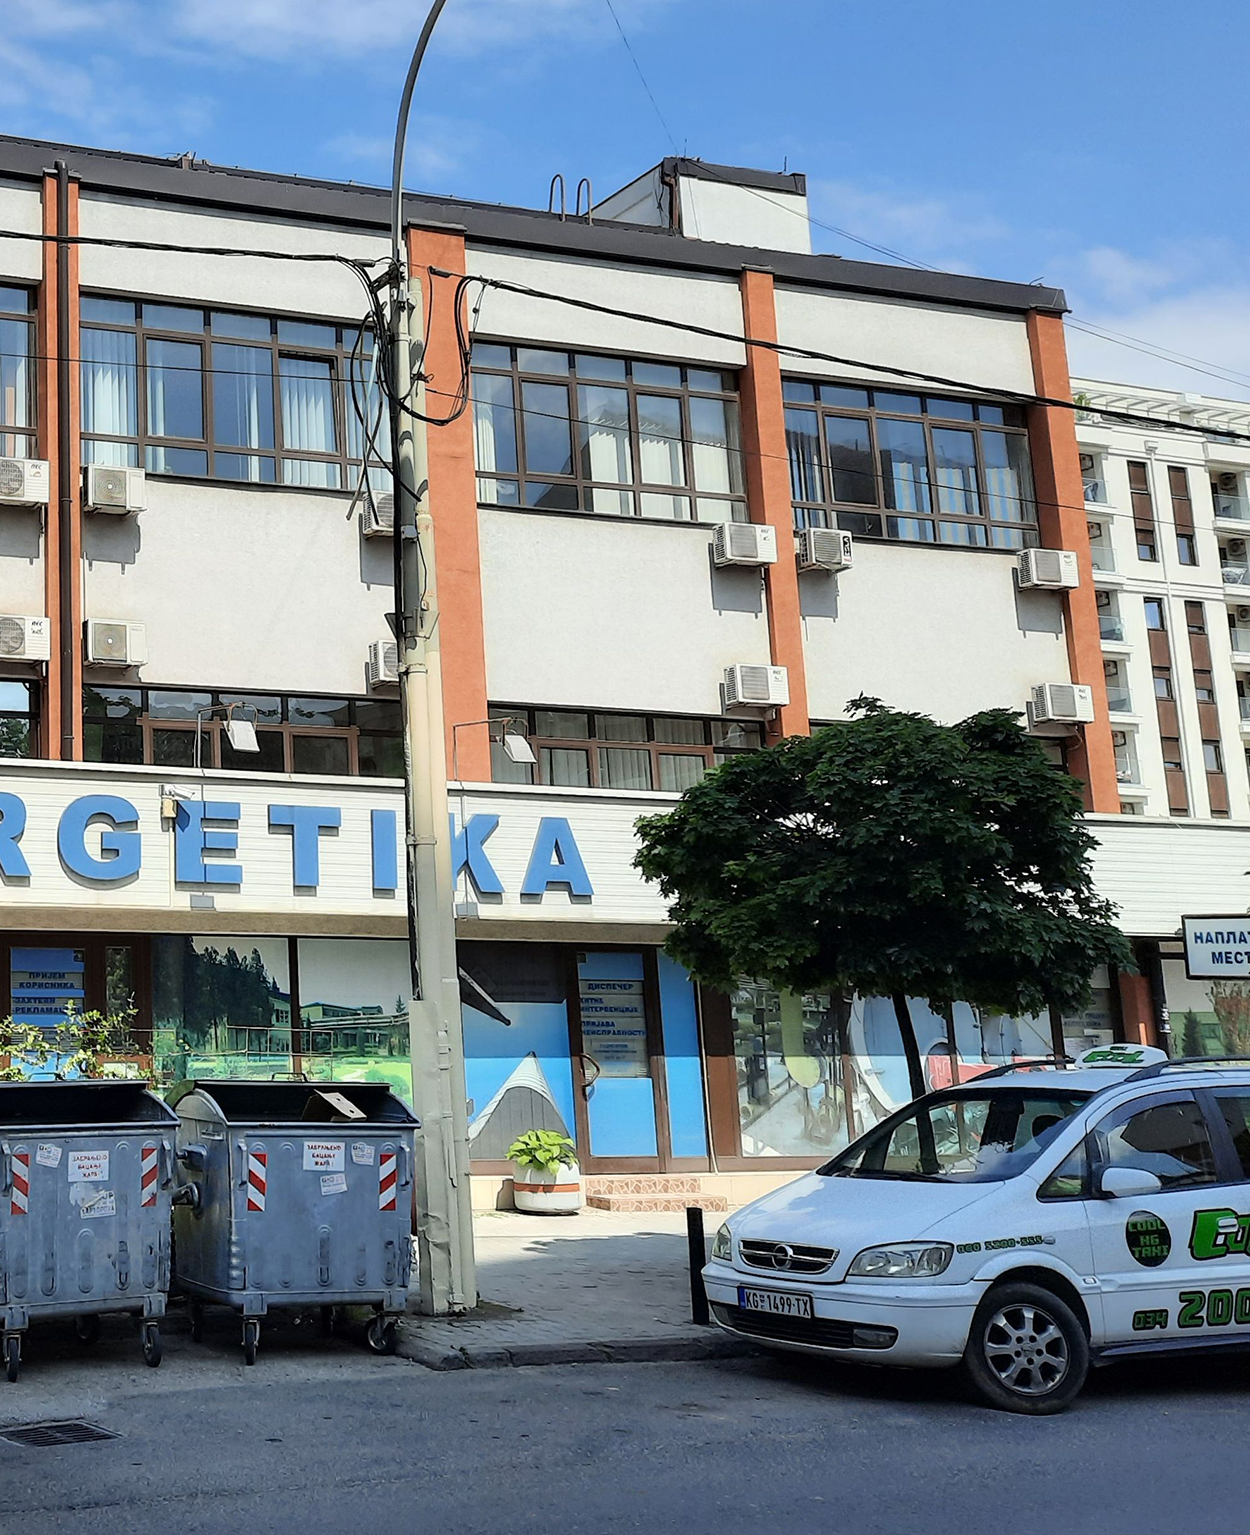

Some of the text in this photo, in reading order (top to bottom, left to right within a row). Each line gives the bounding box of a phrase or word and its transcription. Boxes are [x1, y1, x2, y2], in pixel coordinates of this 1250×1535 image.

[1193, 931, 1250, 944] НАПЛА
[19, 981, 75, 989] КОРИСНИКА
[587, 983, 634, 991] ДИСПЕЧЕР
[745, 1291, 759, 1308] KG
[1132, 1308, 1169, 1331] 034
